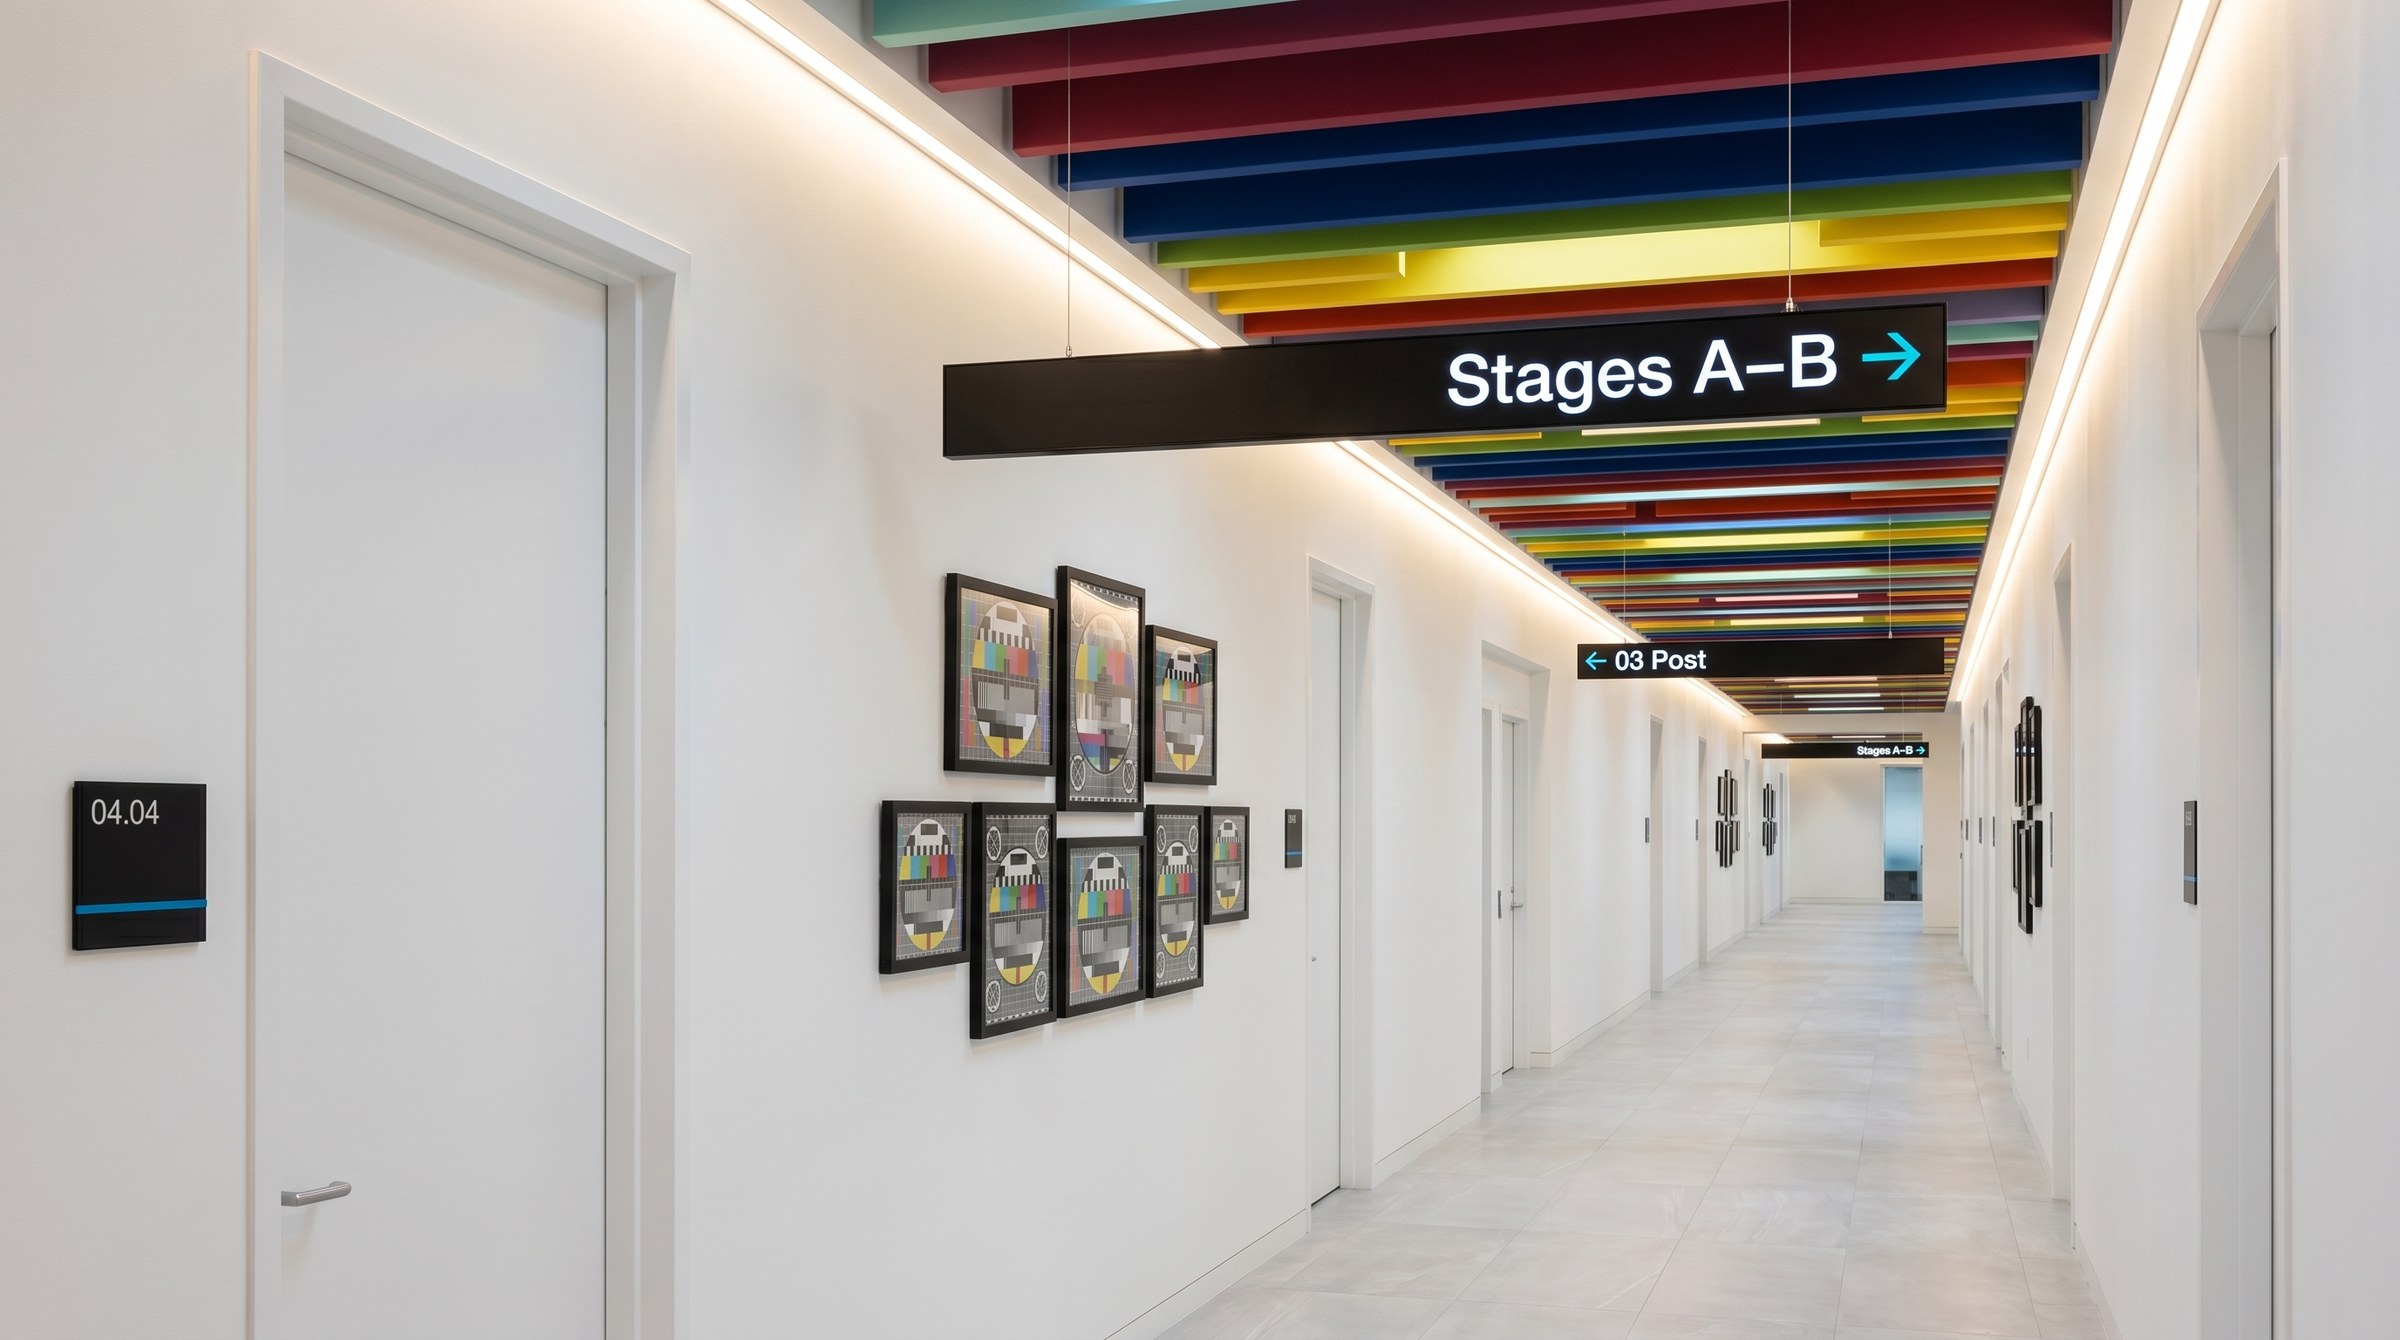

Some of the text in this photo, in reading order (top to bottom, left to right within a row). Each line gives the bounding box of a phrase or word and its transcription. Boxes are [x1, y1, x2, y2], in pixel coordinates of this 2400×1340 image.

[1447, 333, 1838, 415] Stages A–B
[1614, 649, 1707, 671] 03 Post
[1856, 745, 1891, 757] Stages
[91, 798, 160, 826] 04.04
